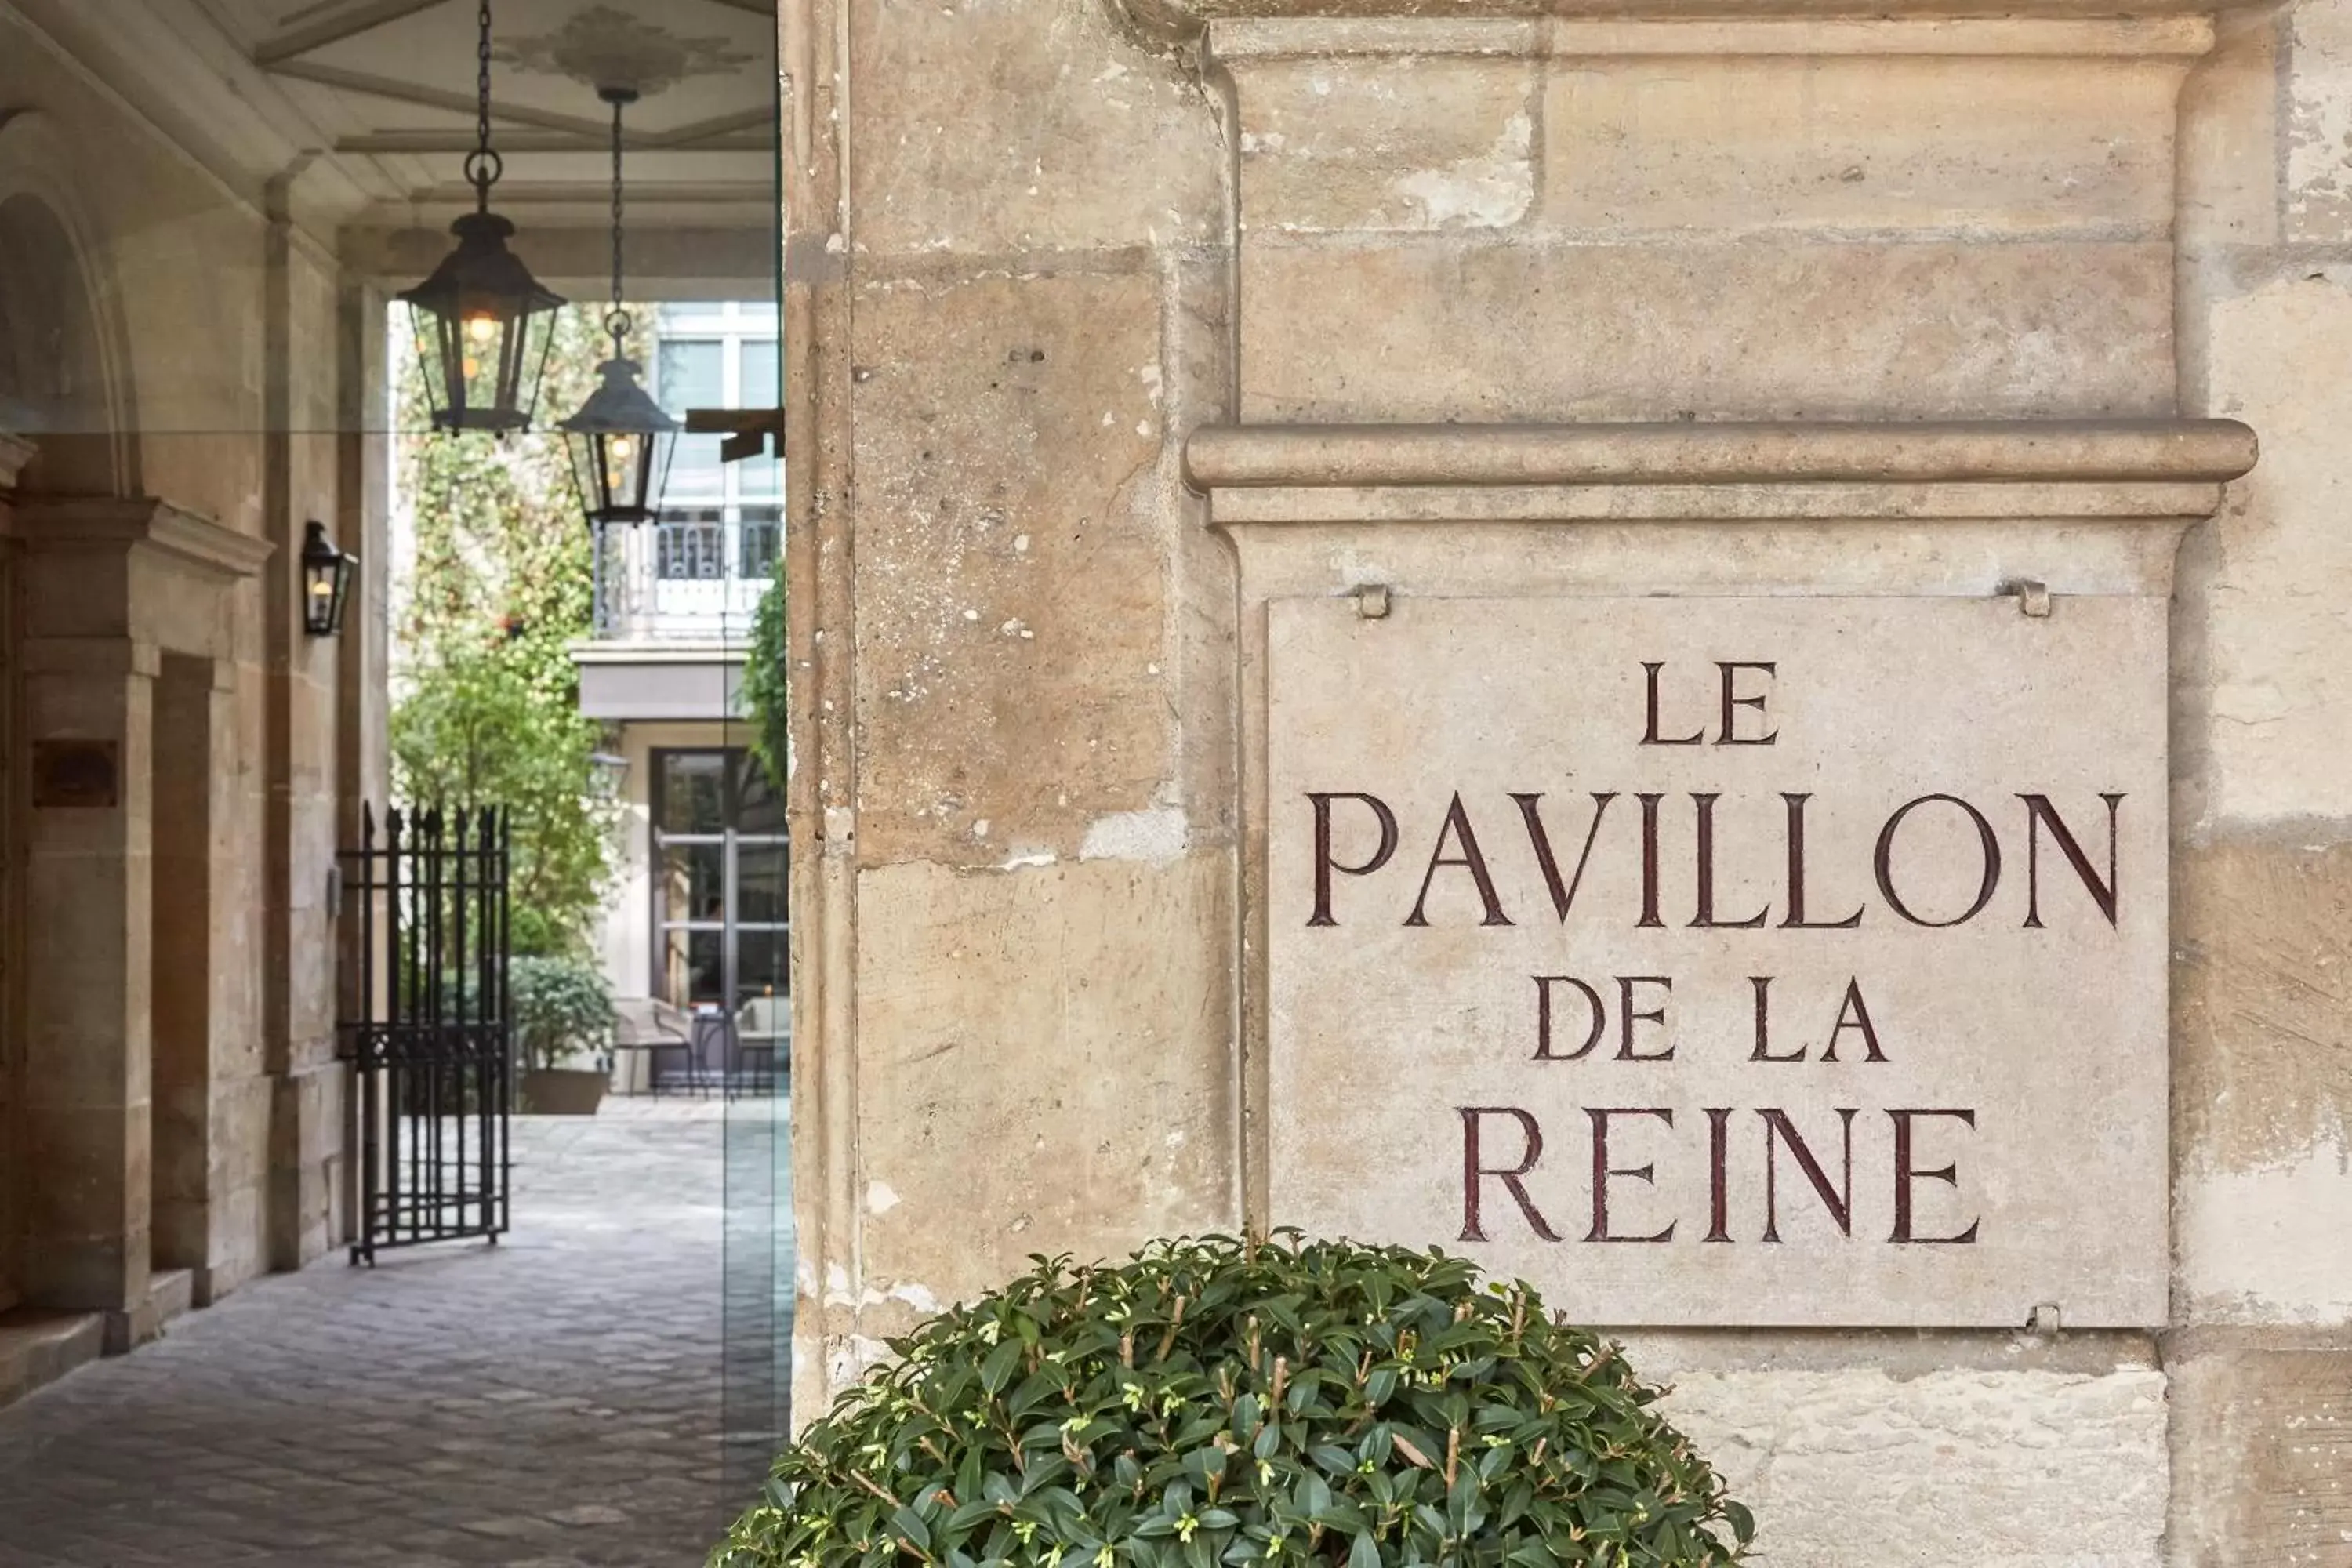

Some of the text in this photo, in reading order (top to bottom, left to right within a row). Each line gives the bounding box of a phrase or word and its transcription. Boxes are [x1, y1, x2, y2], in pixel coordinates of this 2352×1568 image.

[1638, 661, 1779, 746] LE
[1304, 789, 2129, 931] PAVILLON
[1530, 975, 1890, 1063] DE LA
[1456, 1106, 1980, 1245] REINE
